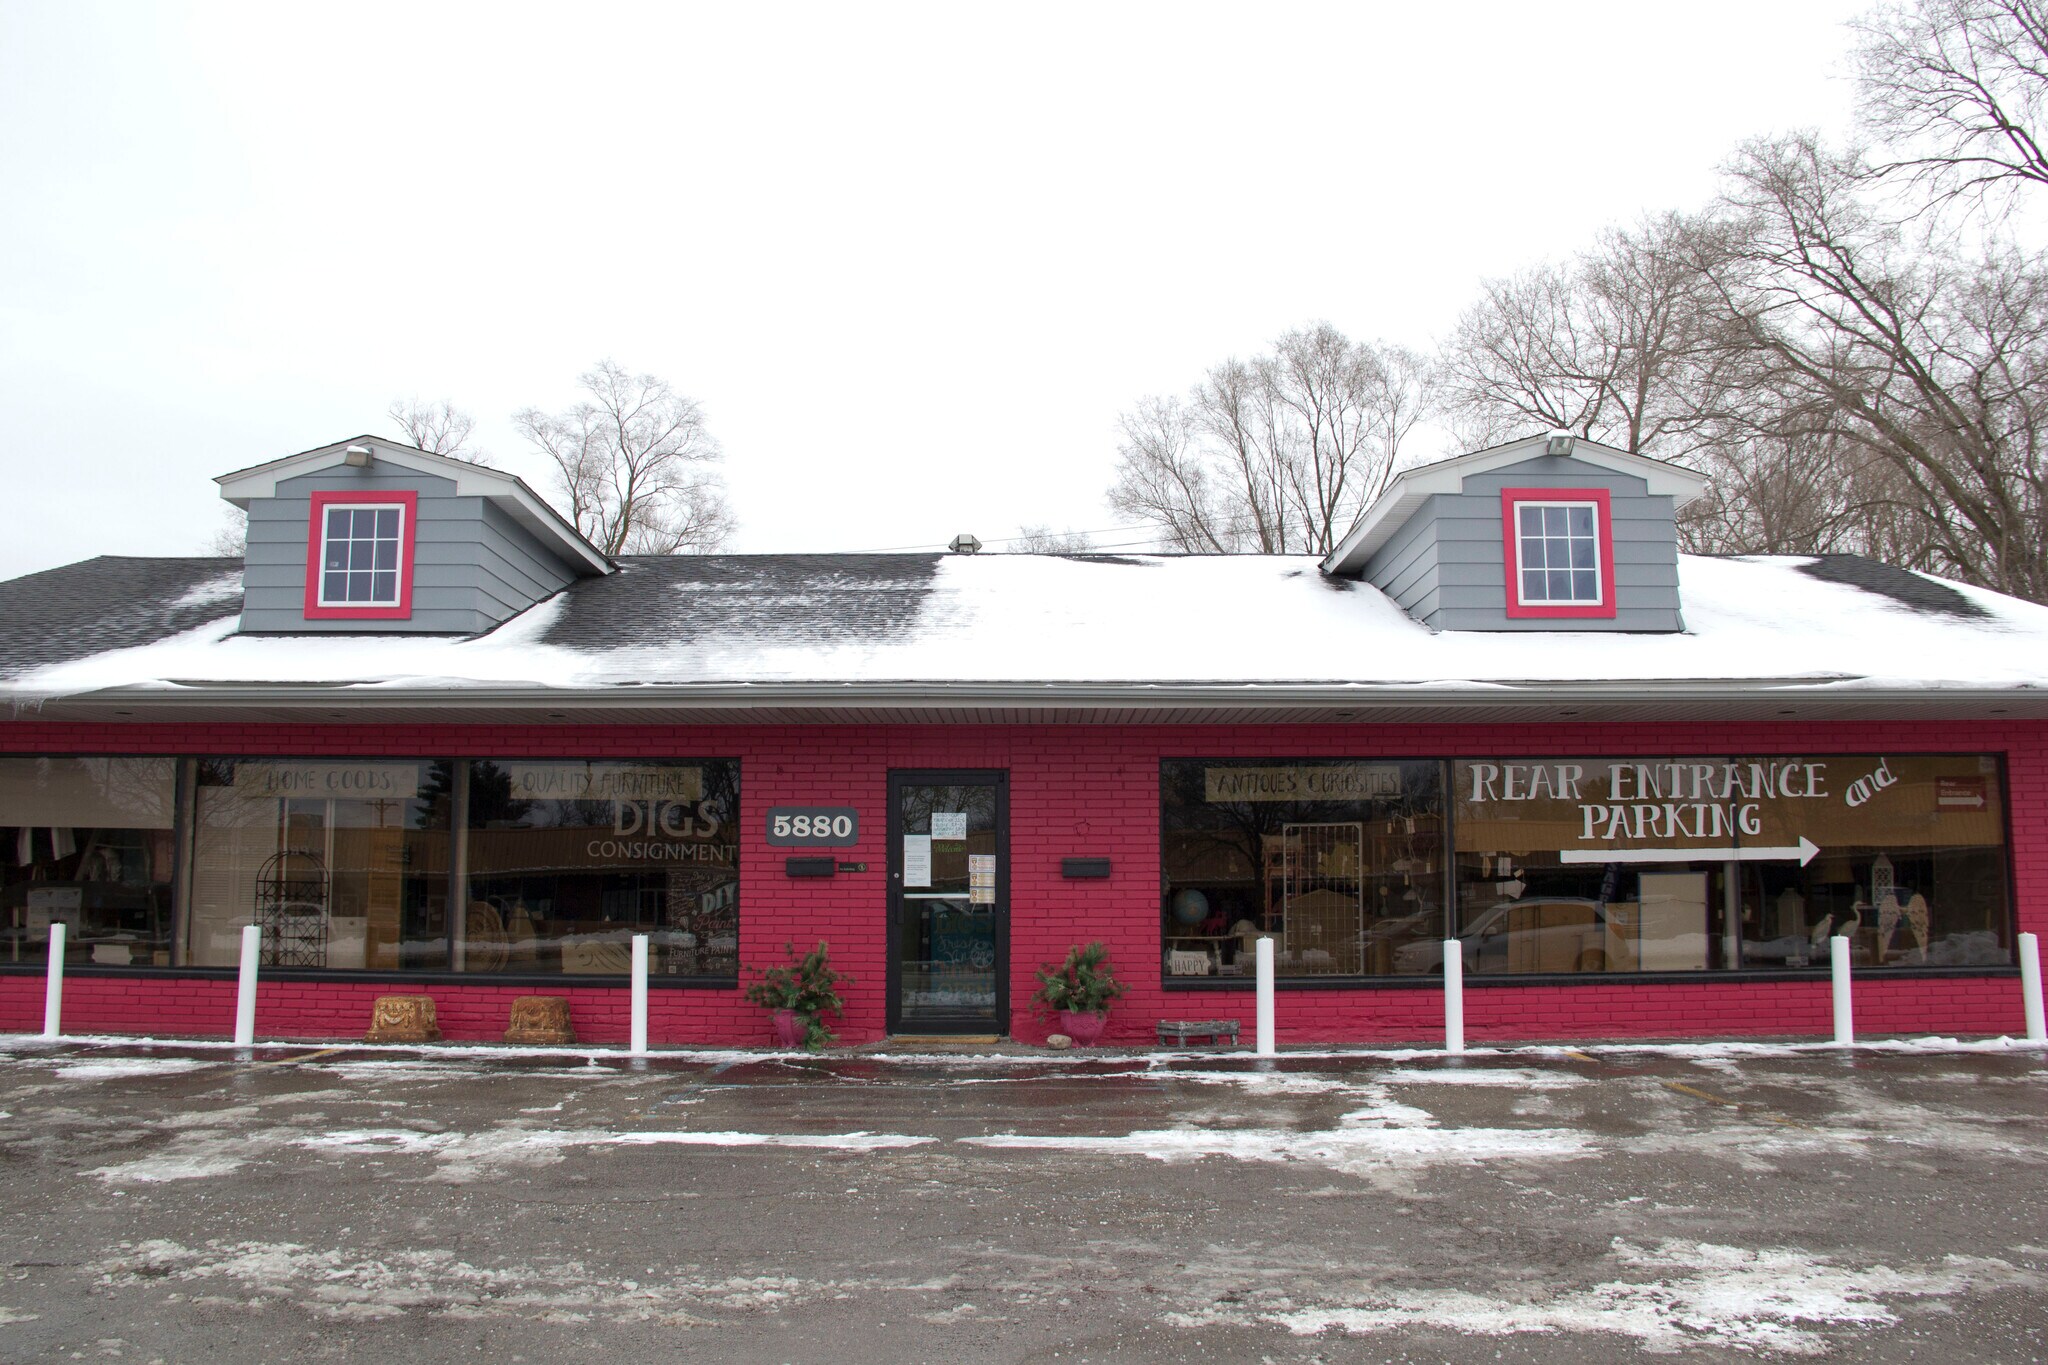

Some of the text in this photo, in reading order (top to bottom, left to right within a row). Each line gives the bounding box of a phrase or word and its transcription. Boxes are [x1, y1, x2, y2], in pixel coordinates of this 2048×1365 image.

[266, 769, 391, 790] HOME GOODS
[522, 771, 686, 796] QUALITY FURNITURE
[1217, 771, 1398, 794] ANTIQUES CURIOSITIES
[1468, 757, 1898, 808] REAR ENTRANCE and
[613, 798, 719, 838] DIGS
[773, 815, 853, 838] 5880
[1577, 803, 1762, 840] PARKING
[587, 840, 737, 862] CONSIGNMENT
[701, 882, 737, 914] DIY
[669, 945, 733, 958] FURNITURE PAINT
[1174, 959, 1205, 972] HAPPY
